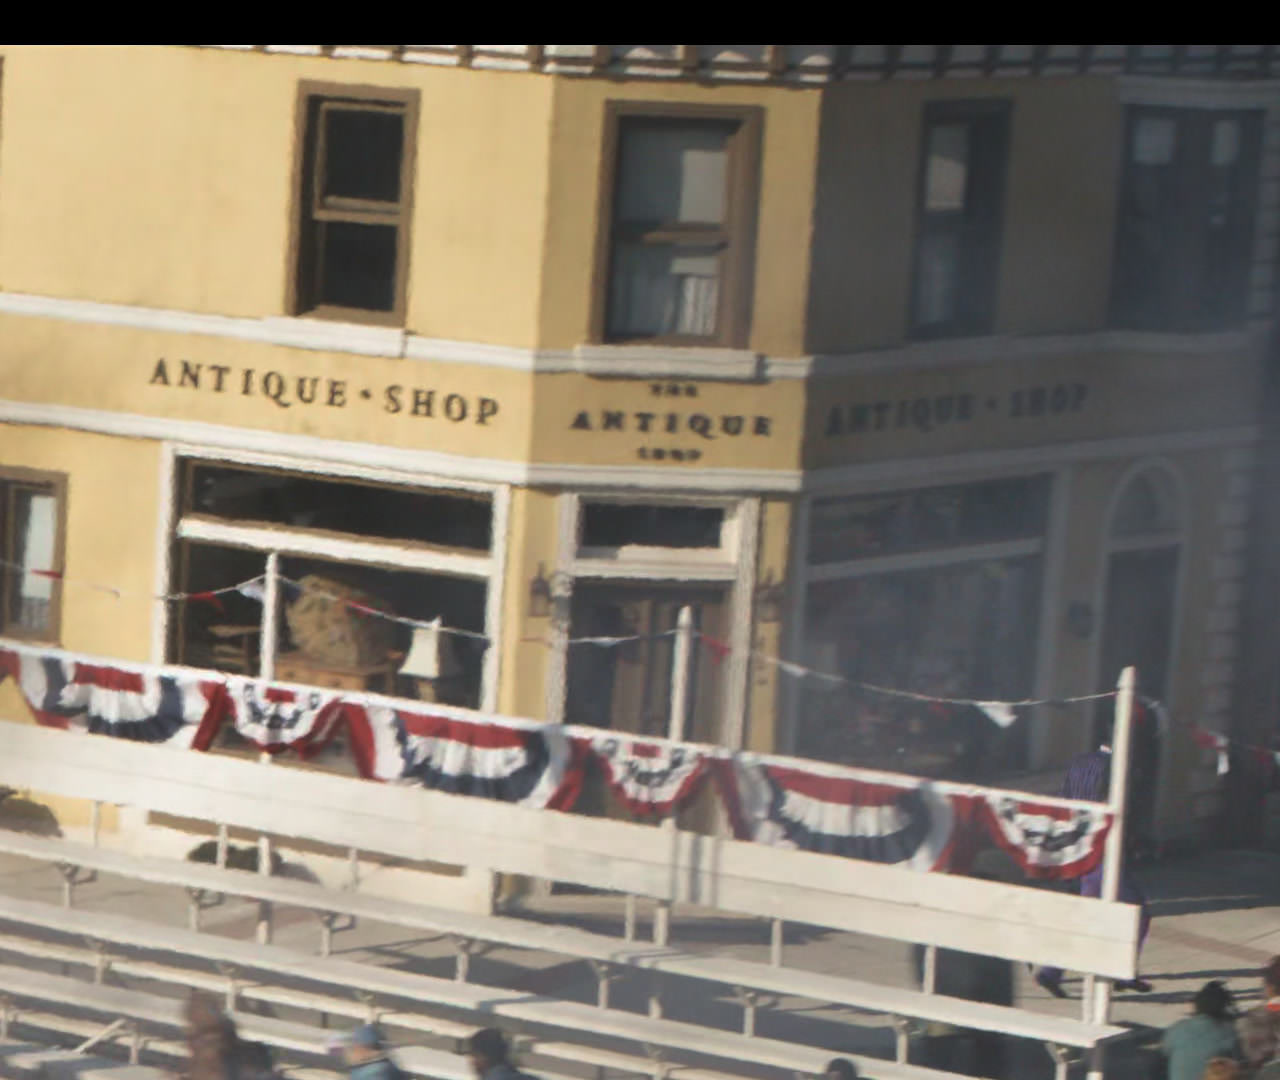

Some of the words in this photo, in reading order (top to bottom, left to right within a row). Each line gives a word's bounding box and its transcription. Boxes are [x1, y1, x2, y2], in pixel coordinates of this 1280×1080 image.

[149, 358, 348, 408] ANTIQUE
[383, 383, 500, 426] SHOP
[570, 411, 773, 439] ANTIQUE
